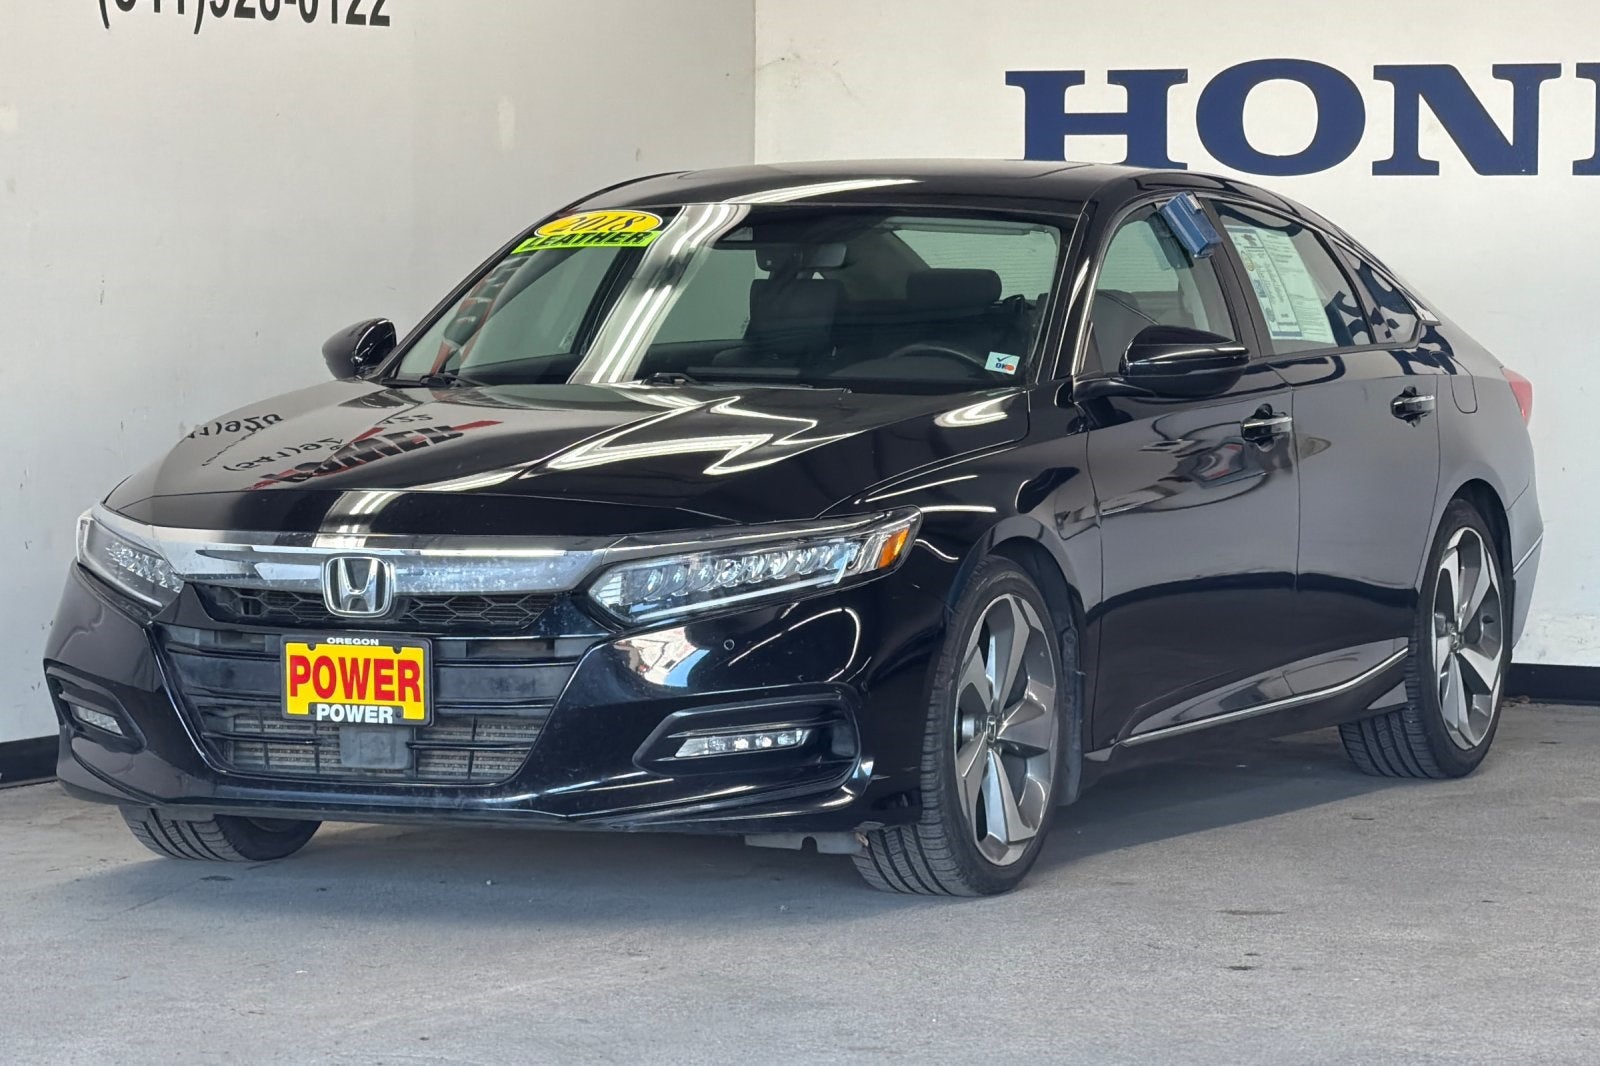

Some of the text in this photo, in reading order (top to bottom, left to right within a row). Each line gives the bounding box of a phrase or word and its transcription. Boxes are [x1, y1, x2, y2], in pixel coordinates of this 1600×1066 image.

[1004, 58, 1600, 176] HON
[527, 231, 653, 248] LEATHER
[326, 637, 379, 646] OREGON
[289, 655, 421, 703] POWER
[316, 703, 393, 724] POWER
